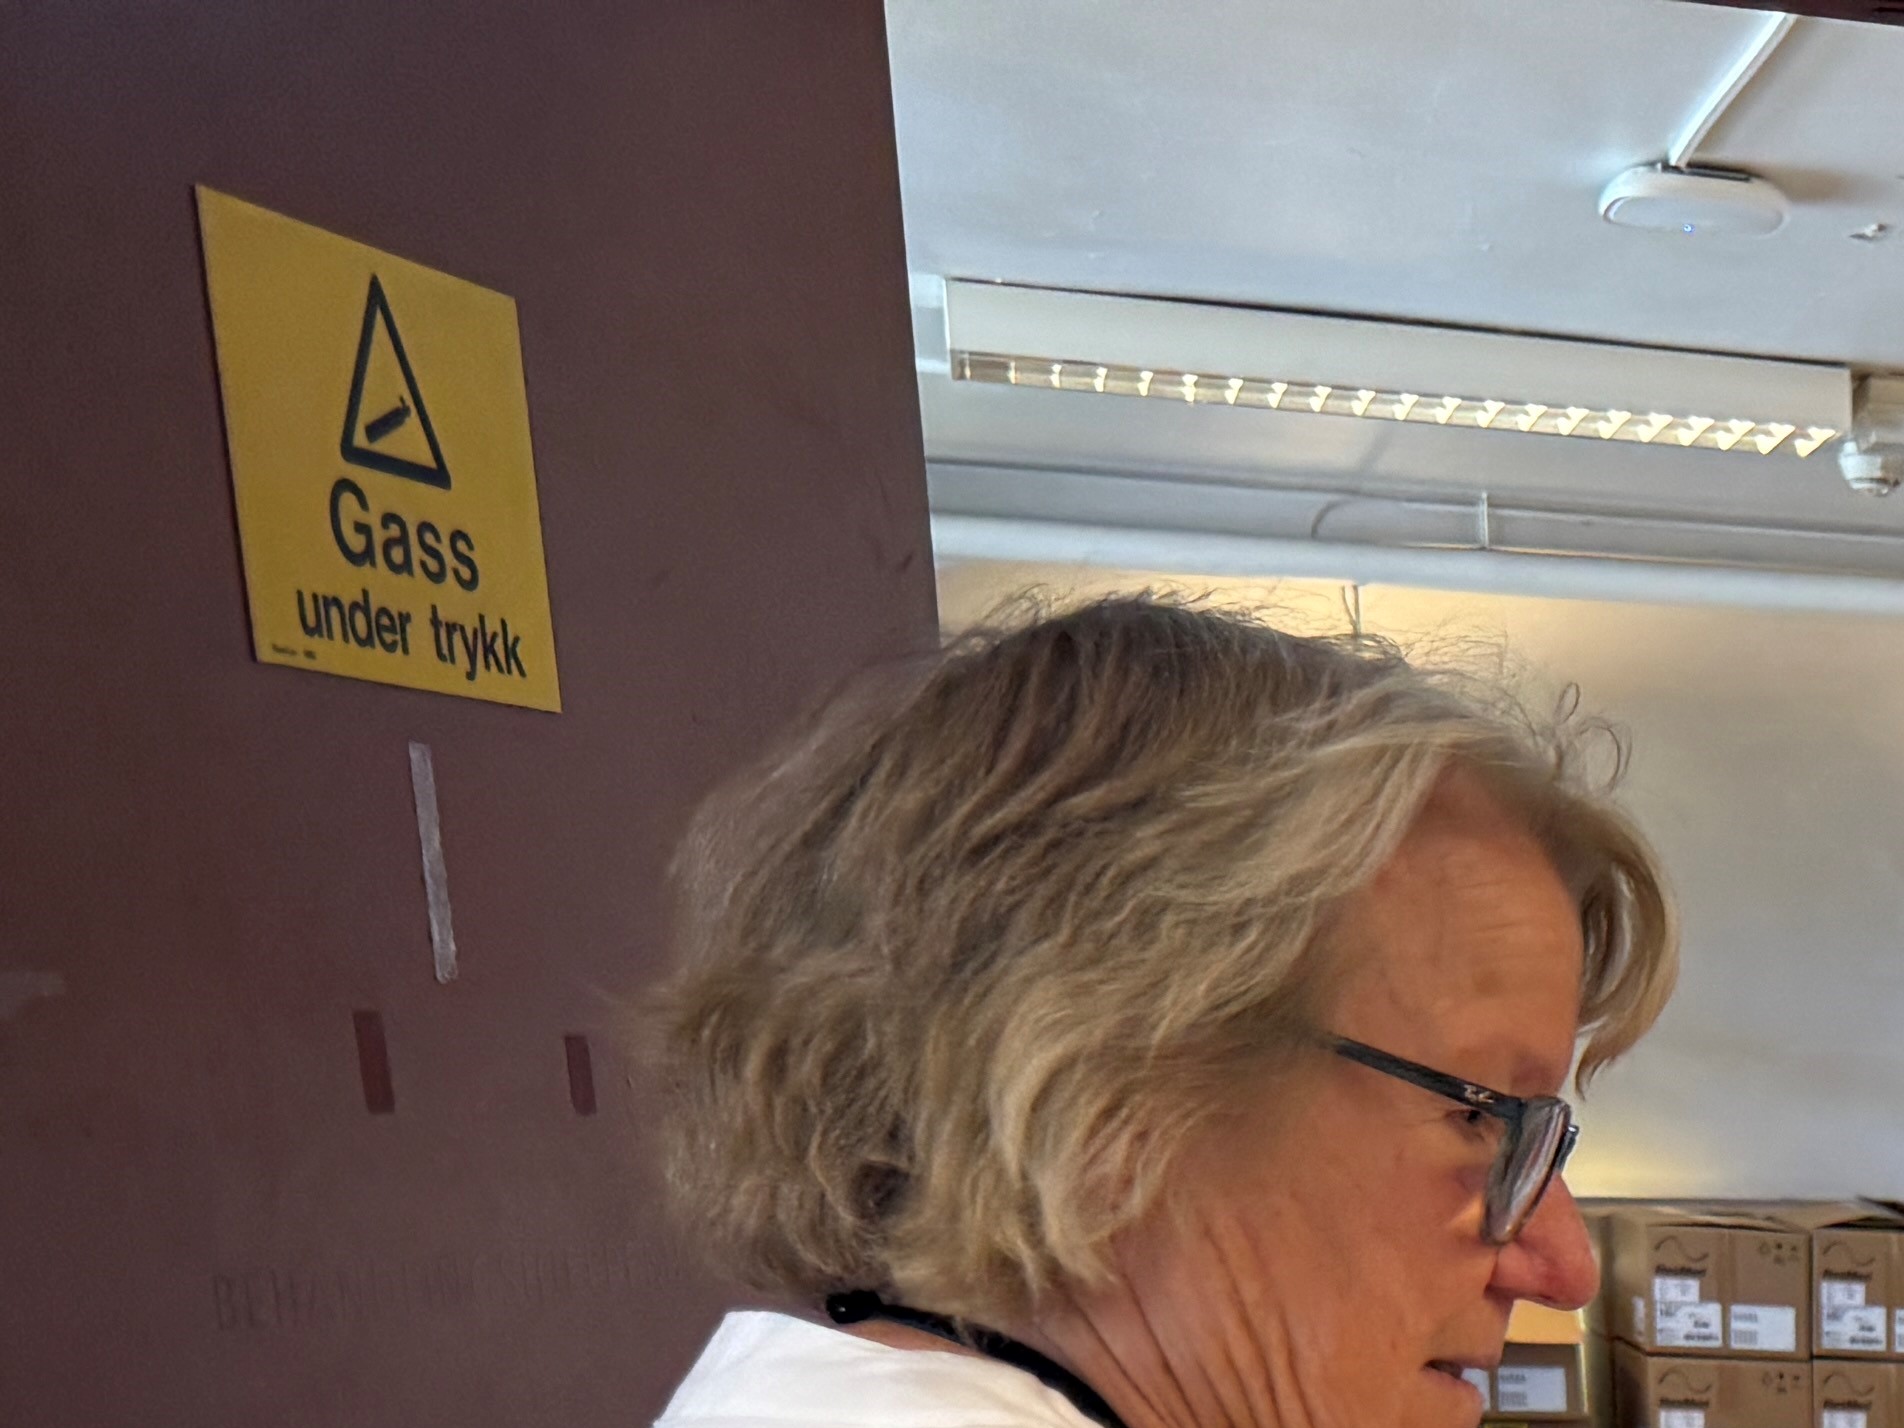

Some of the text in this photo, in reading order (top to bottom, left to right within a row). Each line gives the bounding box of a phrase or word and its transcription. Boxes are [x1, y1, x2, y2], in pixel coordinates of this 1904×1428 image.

[330, 477, 480, 592] Gass
[297, 588, 527, 681] under trykk
